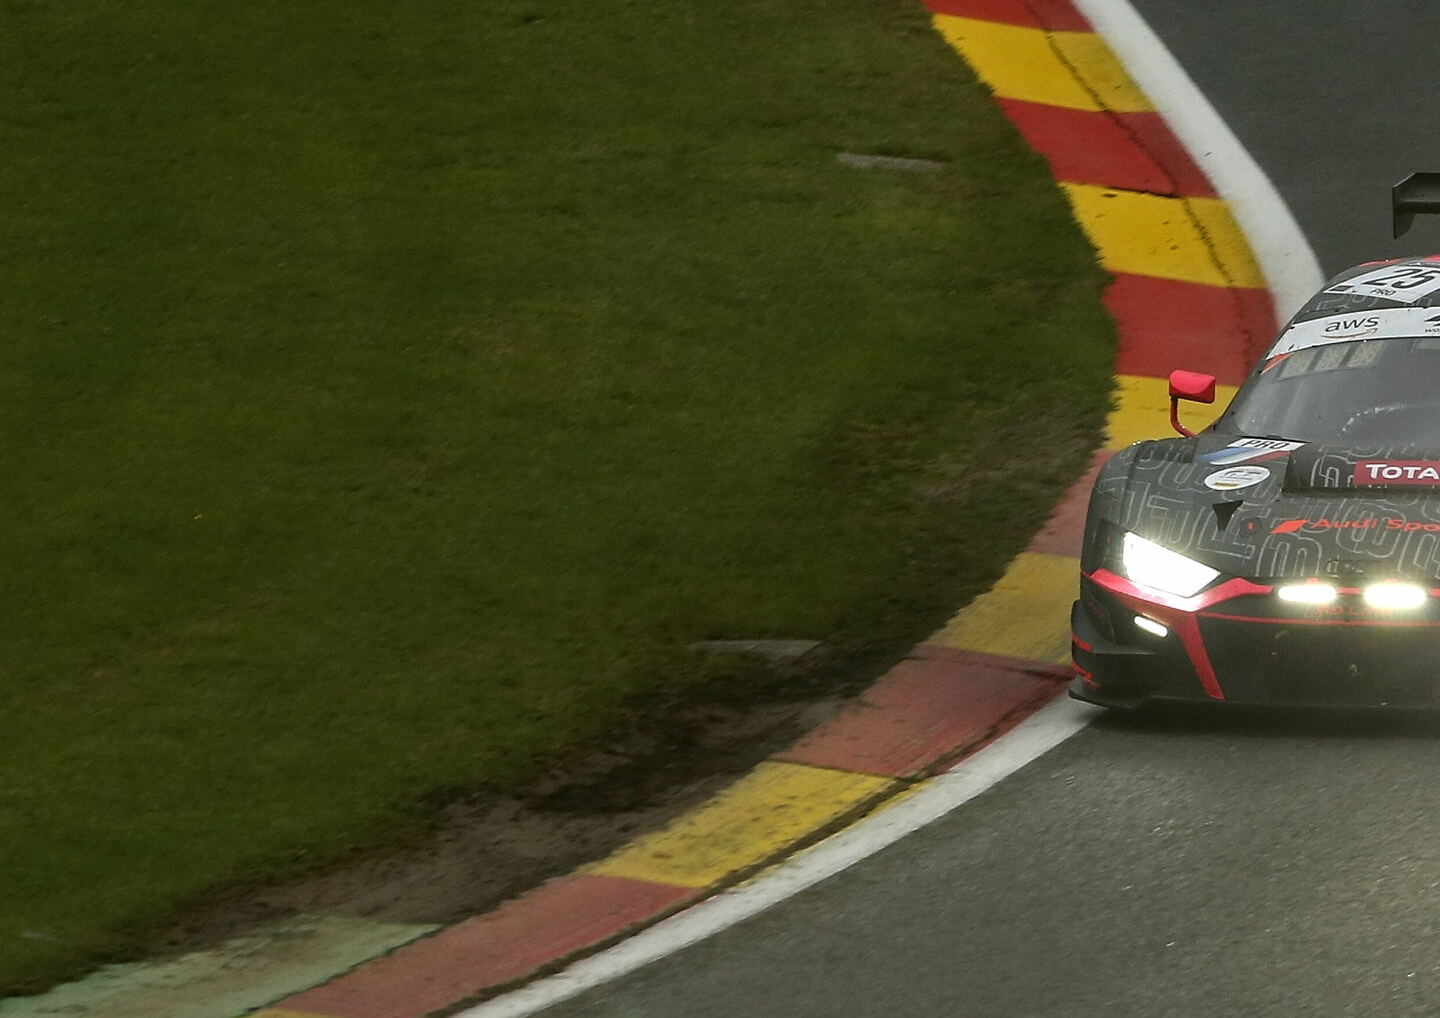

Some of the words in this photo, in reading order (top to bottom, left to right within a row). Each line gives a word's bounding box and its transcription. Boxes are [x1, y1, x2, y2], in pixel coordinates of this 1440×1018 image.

[1371, 288, 1396, 297] PRO
[1325, 316, 1379, 332] aws
[1242, 439, 1290, 449] PRO
[1310, 518, 1378, 529] Audi
